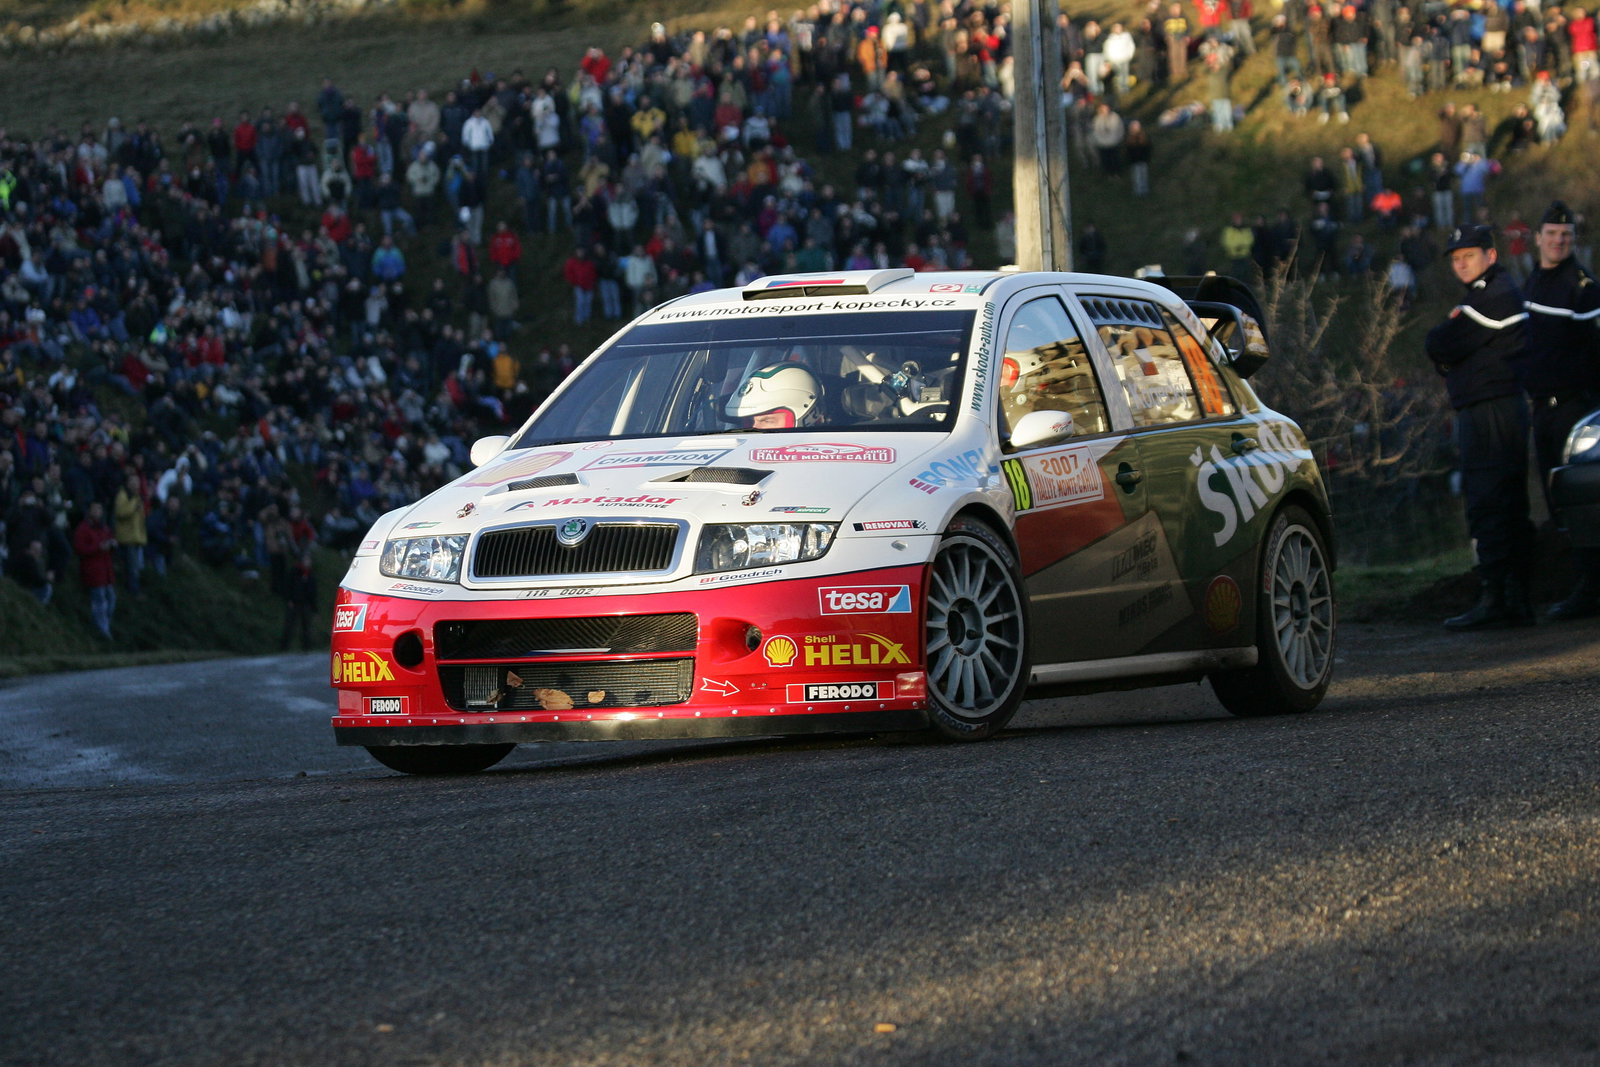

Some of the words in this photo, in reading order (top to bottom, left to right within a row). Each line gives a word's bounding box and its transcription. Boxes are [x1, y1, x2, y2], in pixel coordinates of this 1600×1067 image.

[660, 298, 957, 321] www.motorsport-kopecky.cz
[970, 301, 996, 412] www.skoda-auto.com
[597, 452, 717, 466] CHAMPION
[756, 453, 799, 461] RALLYE
[1040, 454, 1078, 476] 2007
[1004, 458, 1031, 511] 18
[543, 494, 683, 507] Matador
[864, 520, 913, 531] RENOVAK
[700, 568, 783, 584] BFGoodrich
[825, 590, 883, 611] tesa
[336, 608, 355, 628] tesa
[804, 635, 836, 643] Shell
[803, 632, 912, 667] HELIX
[343, 650, 396, 682] HELIX
[808, 684, 874, 700] FERODO
[371, 699, 400, 713] FERODO
